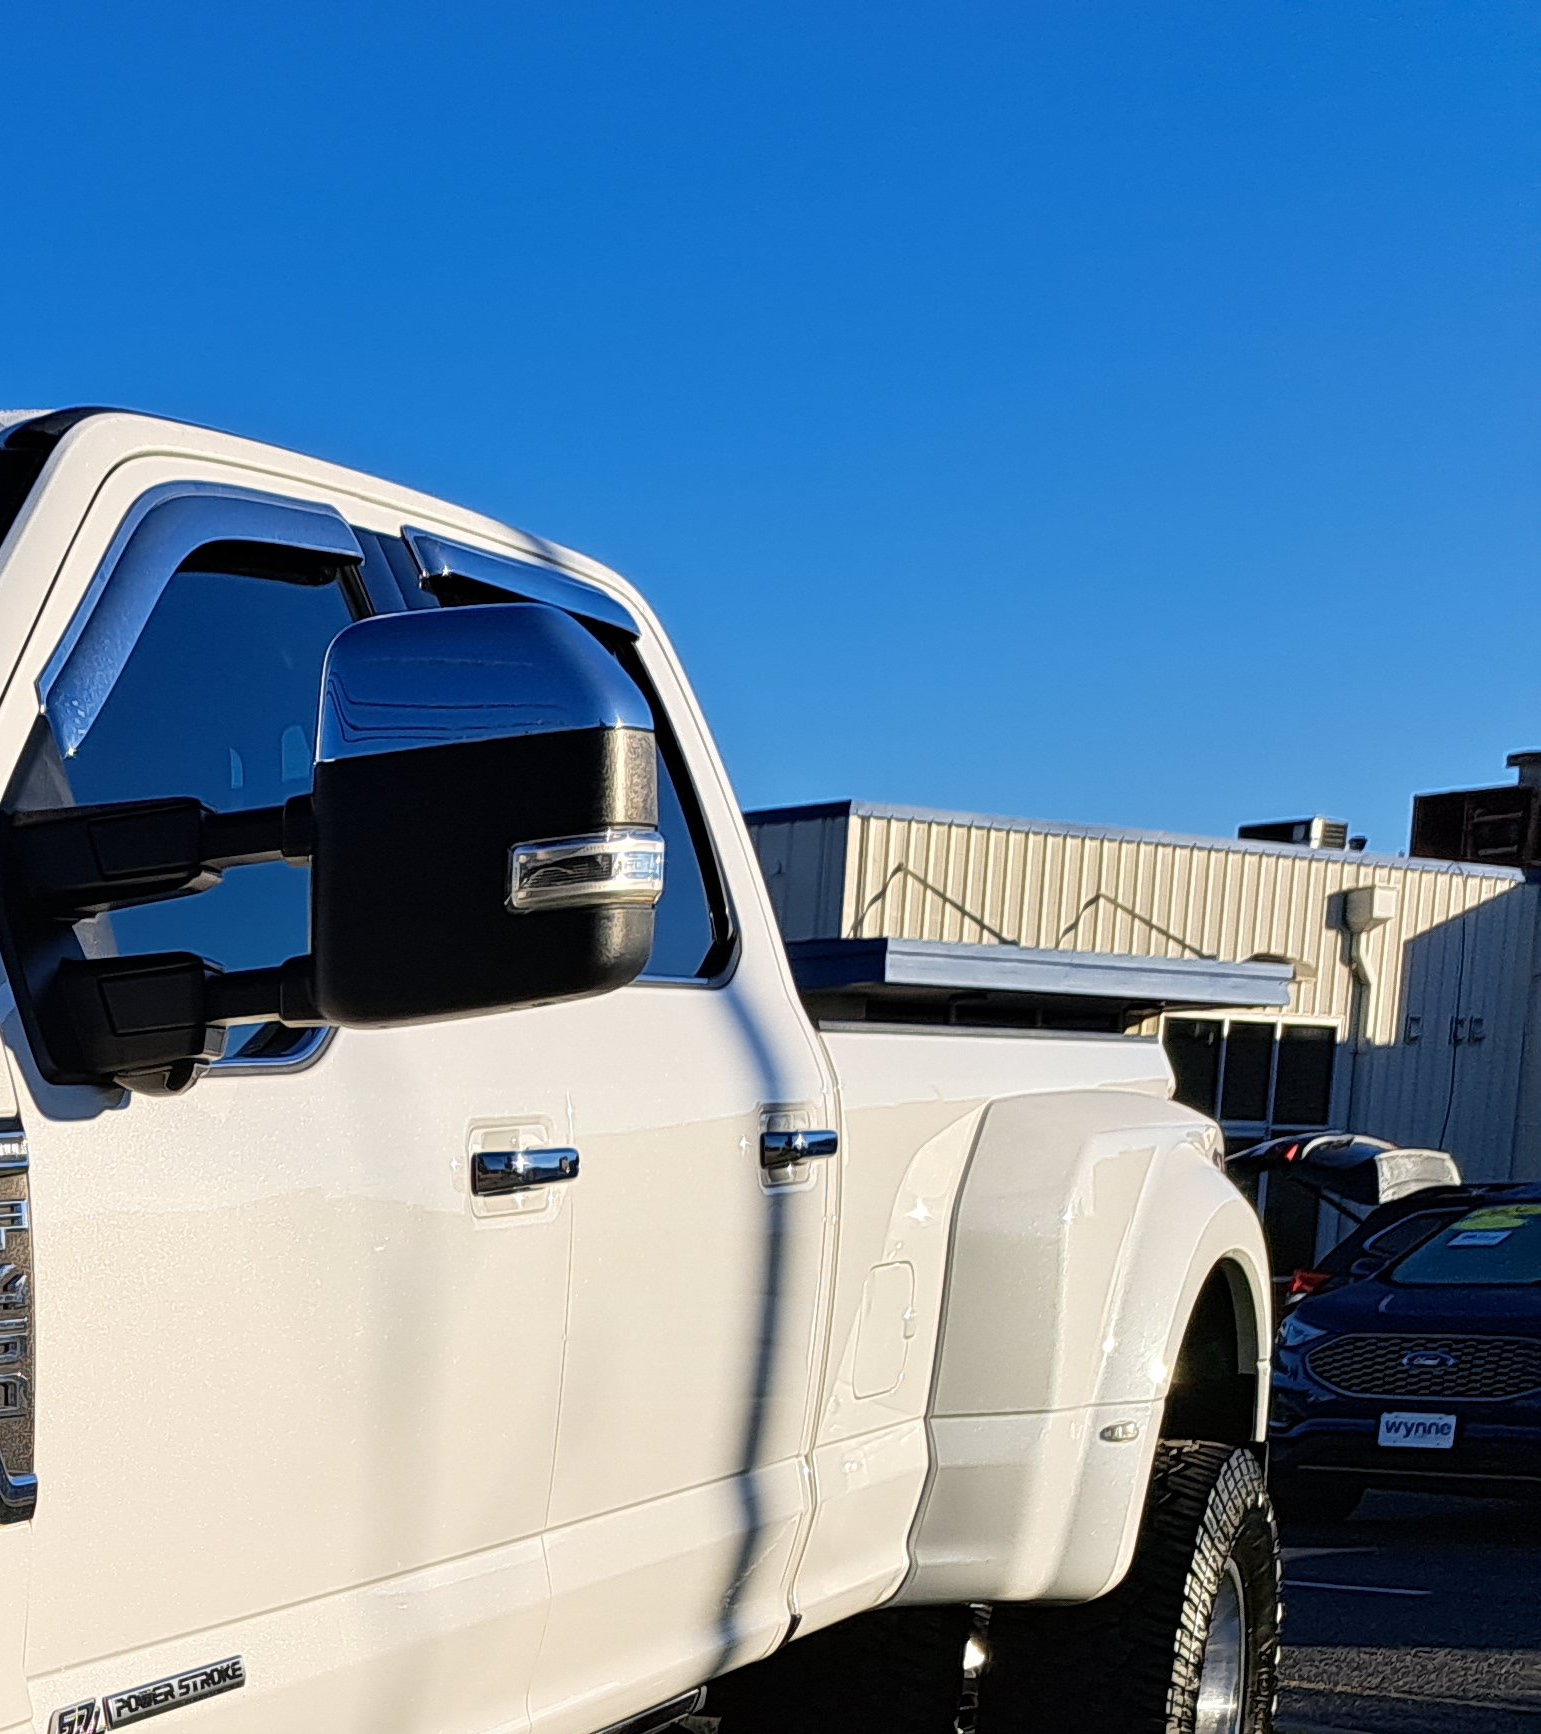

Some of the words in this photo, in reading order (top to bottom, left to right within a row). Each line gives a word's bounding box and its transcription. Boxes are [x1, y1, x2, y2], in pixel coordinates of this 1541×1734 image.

[1384, 1416, 1453, 1440] wynne
[114, 1685, 175, 1718] POWER
[177, 1660, 244, 1698] STROKE
